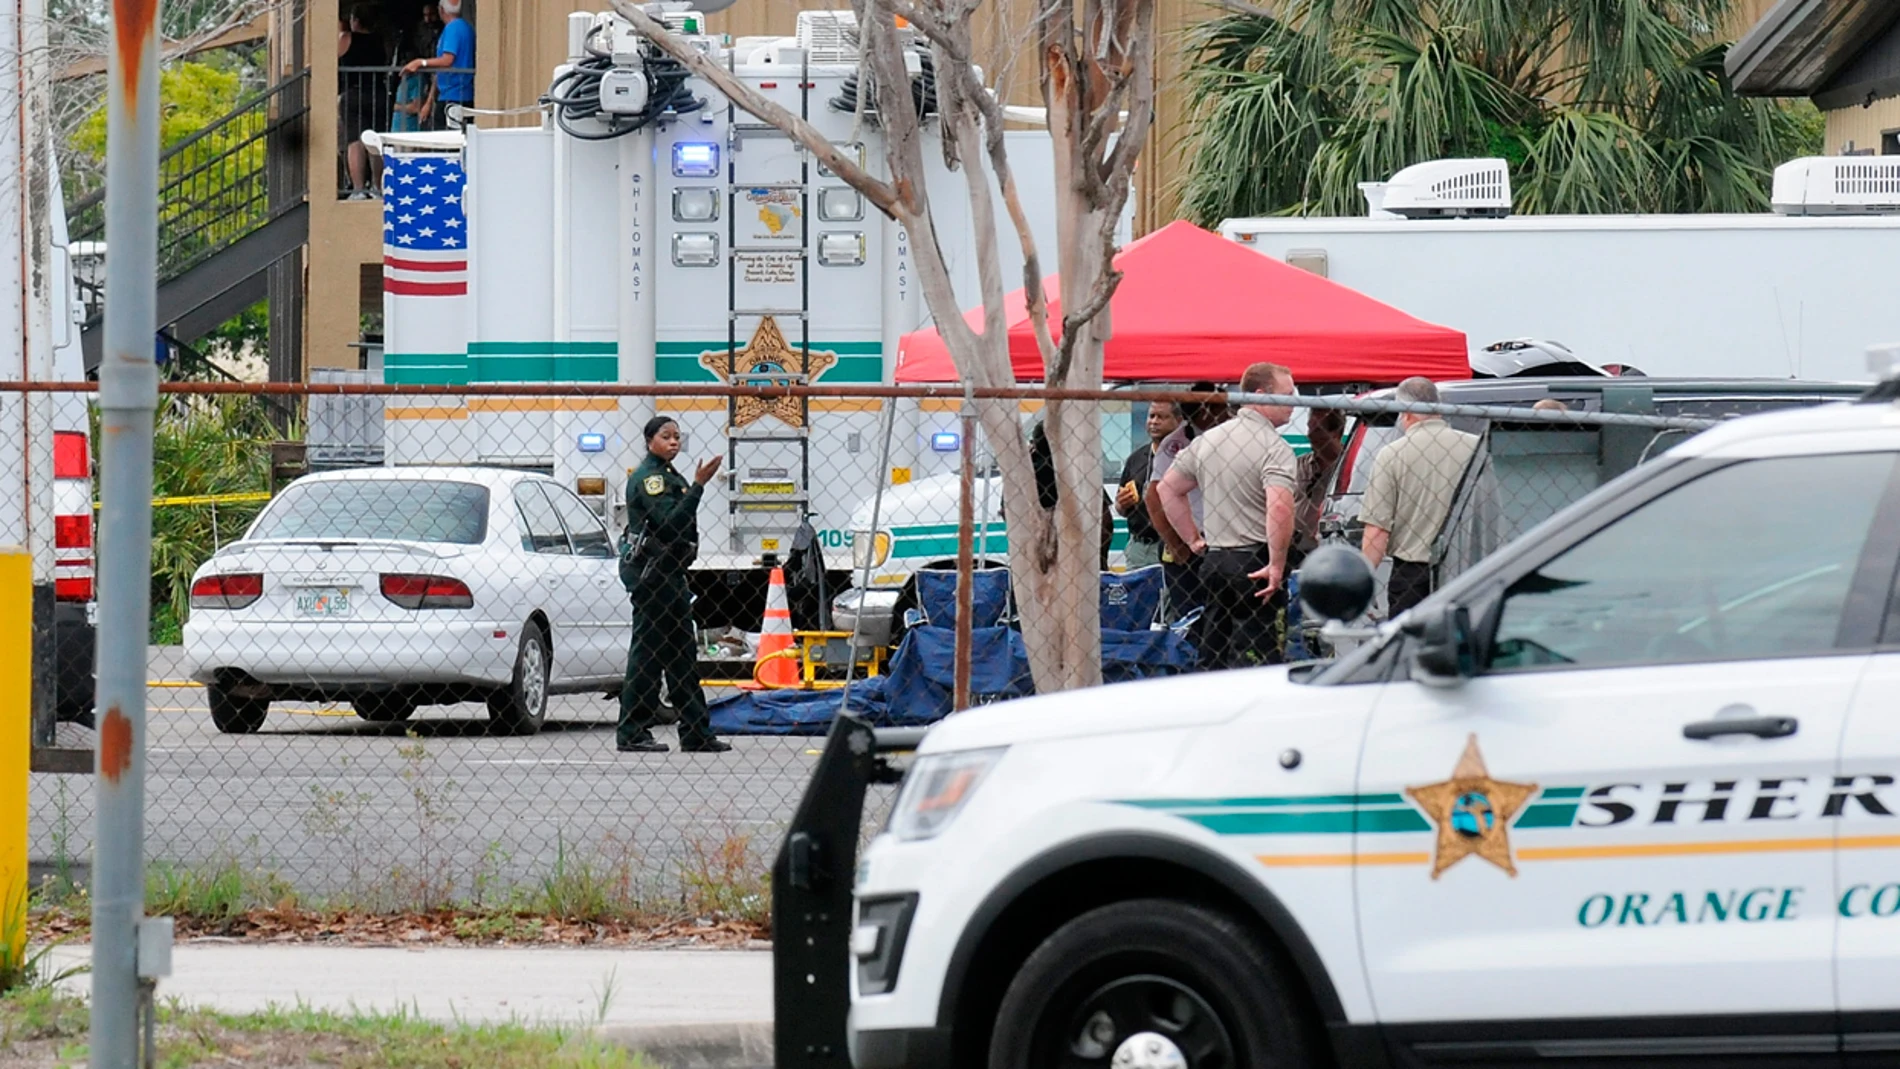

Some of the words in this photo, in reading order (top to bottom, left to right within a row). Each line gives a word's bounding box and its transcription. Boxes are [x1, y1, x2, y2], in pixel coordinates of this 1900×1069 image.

[1577, 773, 1897, 828] SHER
[1577, 887, 1805, 930] ORANGE
[1838, 883, 1900, 918] CO
